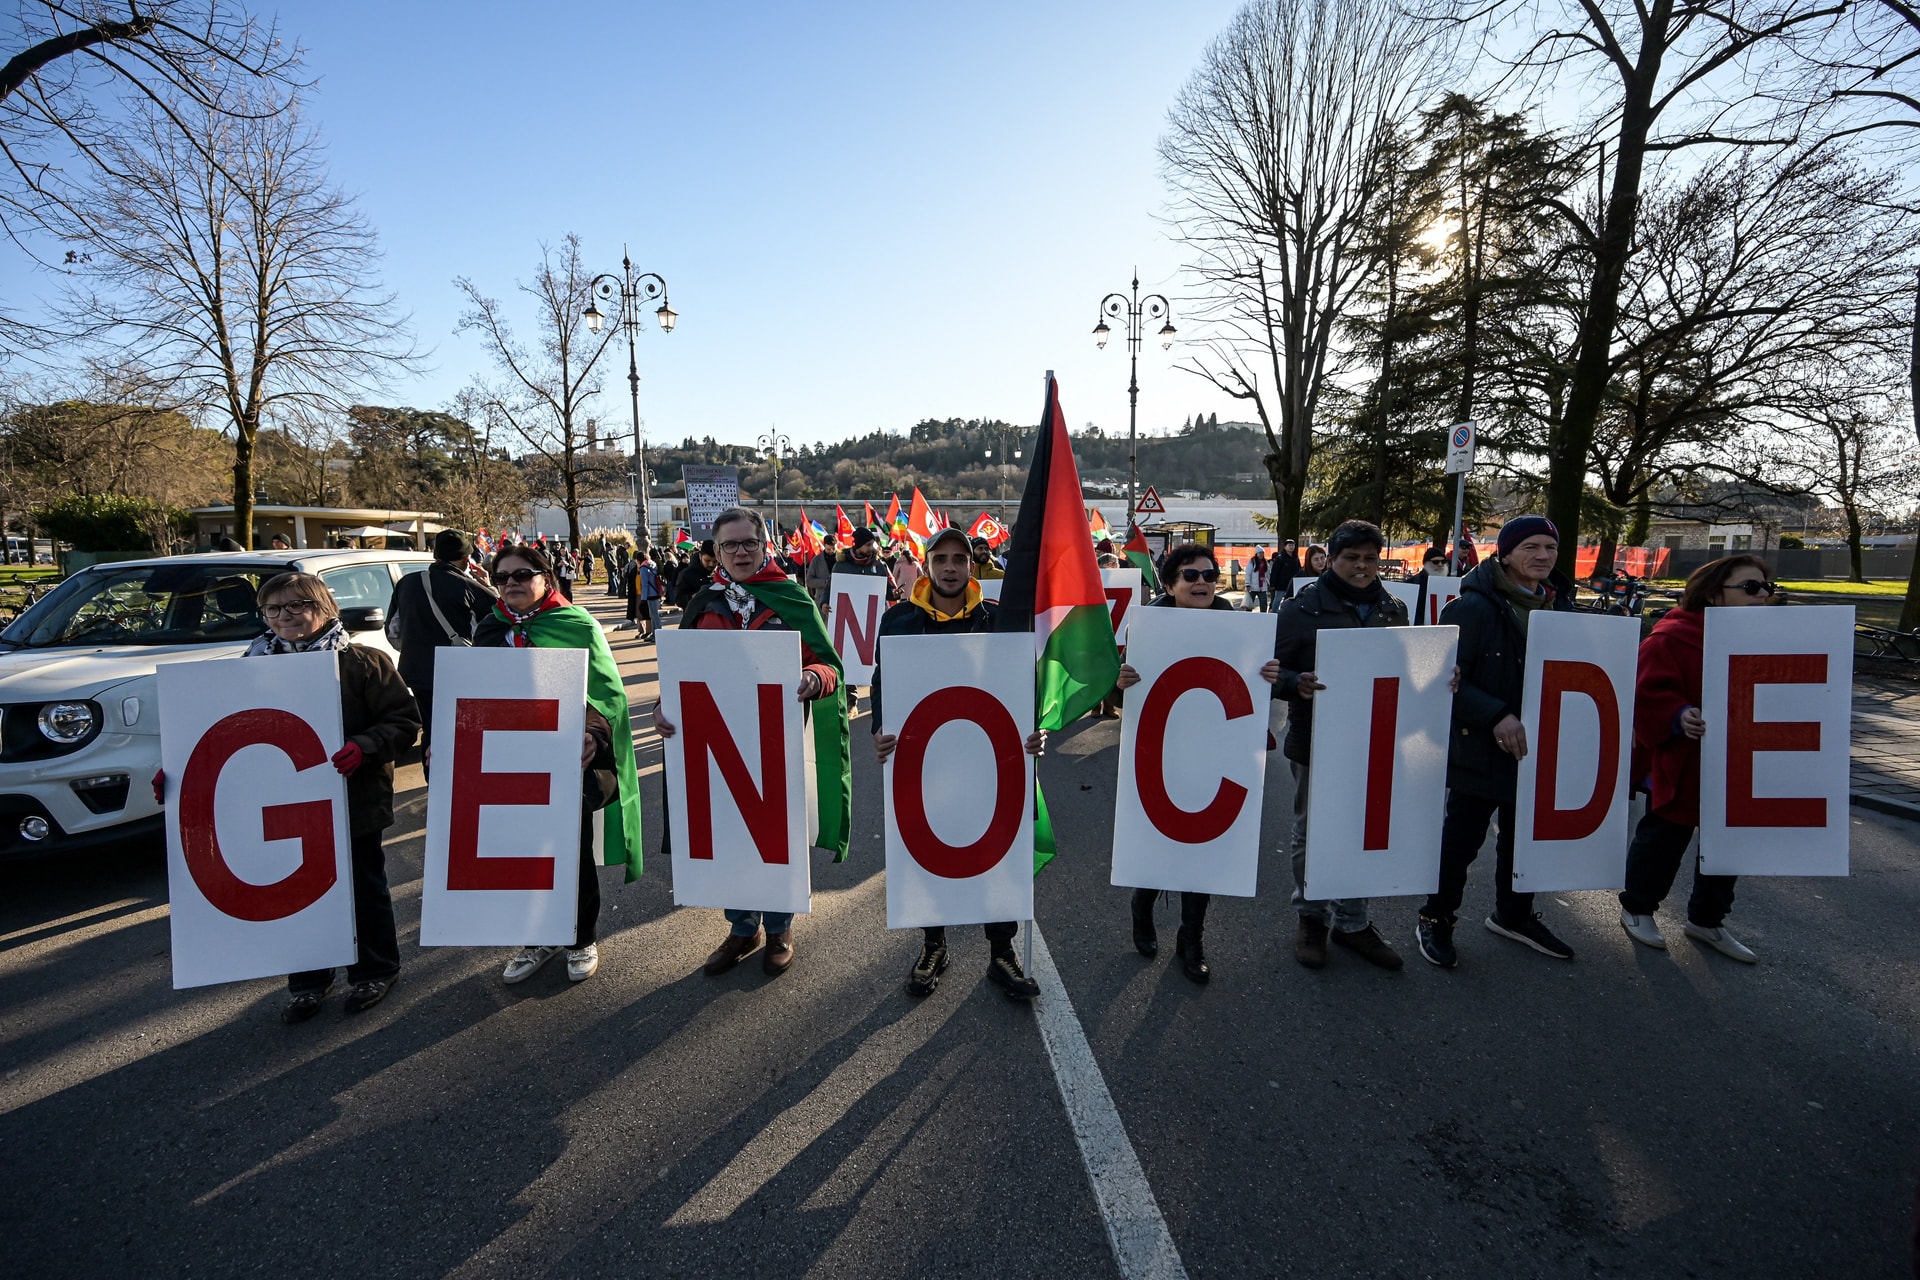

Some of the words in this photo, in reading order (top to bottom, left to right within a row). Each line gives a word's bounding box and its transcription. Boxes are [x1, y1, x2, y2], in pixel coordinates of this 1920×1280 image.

[834, 592, 879, 666] N
[179, 708, 337, 921] G
[447, 699, 559, 890] E
[680, 682, 789, 865] N
[893, 685, 1025, 877] O
[1135, 656, 1254, 844] C
[1364, 677, 1399, 850] I
[1533, 660, 1620, 841] D
[1725, 653, 1828, 828] E
